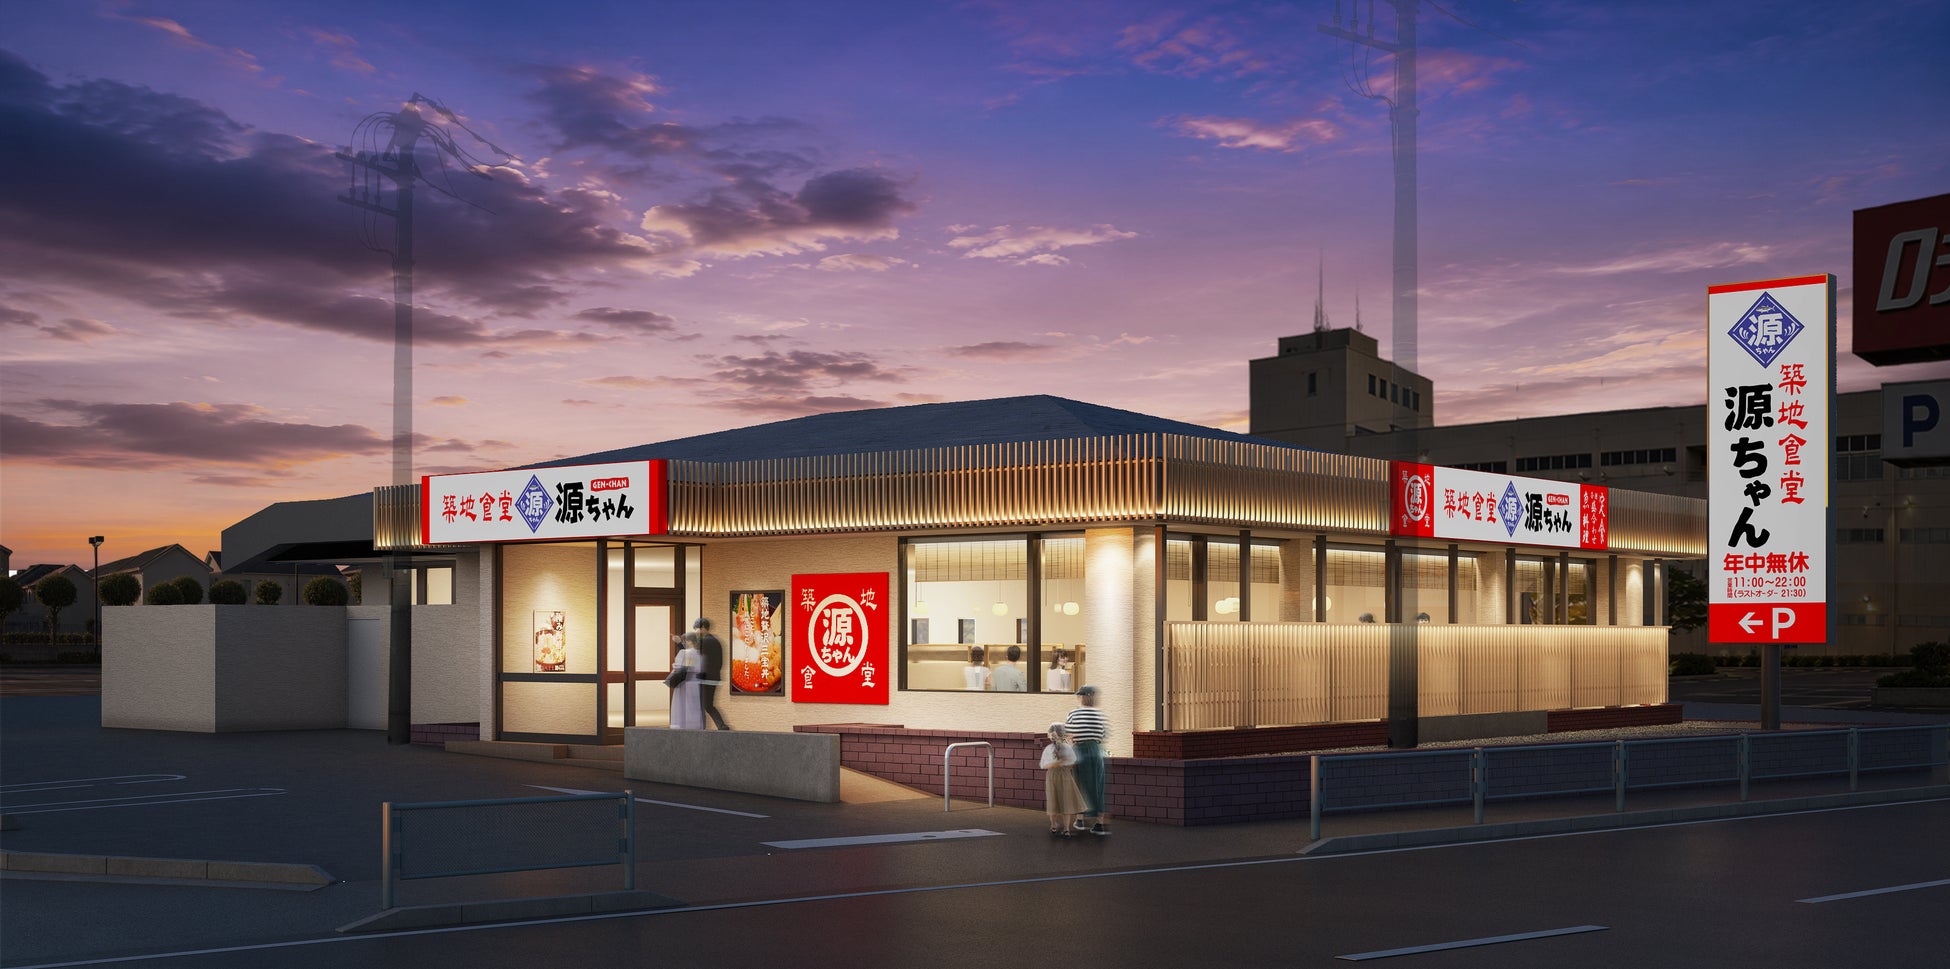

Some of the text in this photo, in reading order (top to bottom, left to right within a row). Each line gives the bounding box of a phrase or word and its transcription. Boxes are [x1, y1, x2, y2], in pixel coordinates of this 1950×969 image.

[1748, 313, 1783, 346] 源
[1755, 346, 1775, 354] ちゃん
[1778, 363, 1809, 505] 築地食堂
[1903, 394, 1940, 448] P
[1724, 383, 1775, 548] 源ちゃん
[441, 489, 513, 524] 築地食堂
[525, 491, 543, 517] 源
[556, 481, 635, 524] 源ちゃん
[1443, 488, 1497, 524] 築地食堂
[1505, 497, 1517, 521] 源
[1525, 491, 1572, 533] 源ちゃん
[1723, 552, 1809, 574] 年中無休
[800, 588, 878, 612] 築 地
[1781, 588, 1806, 598] 21:30)
[822, 608, 854, 647] 源
[1772, 608, 1796, 639] P
[821, 646, 856, 664] ちゃん
[800, 661, 876, 689] 食 堂
